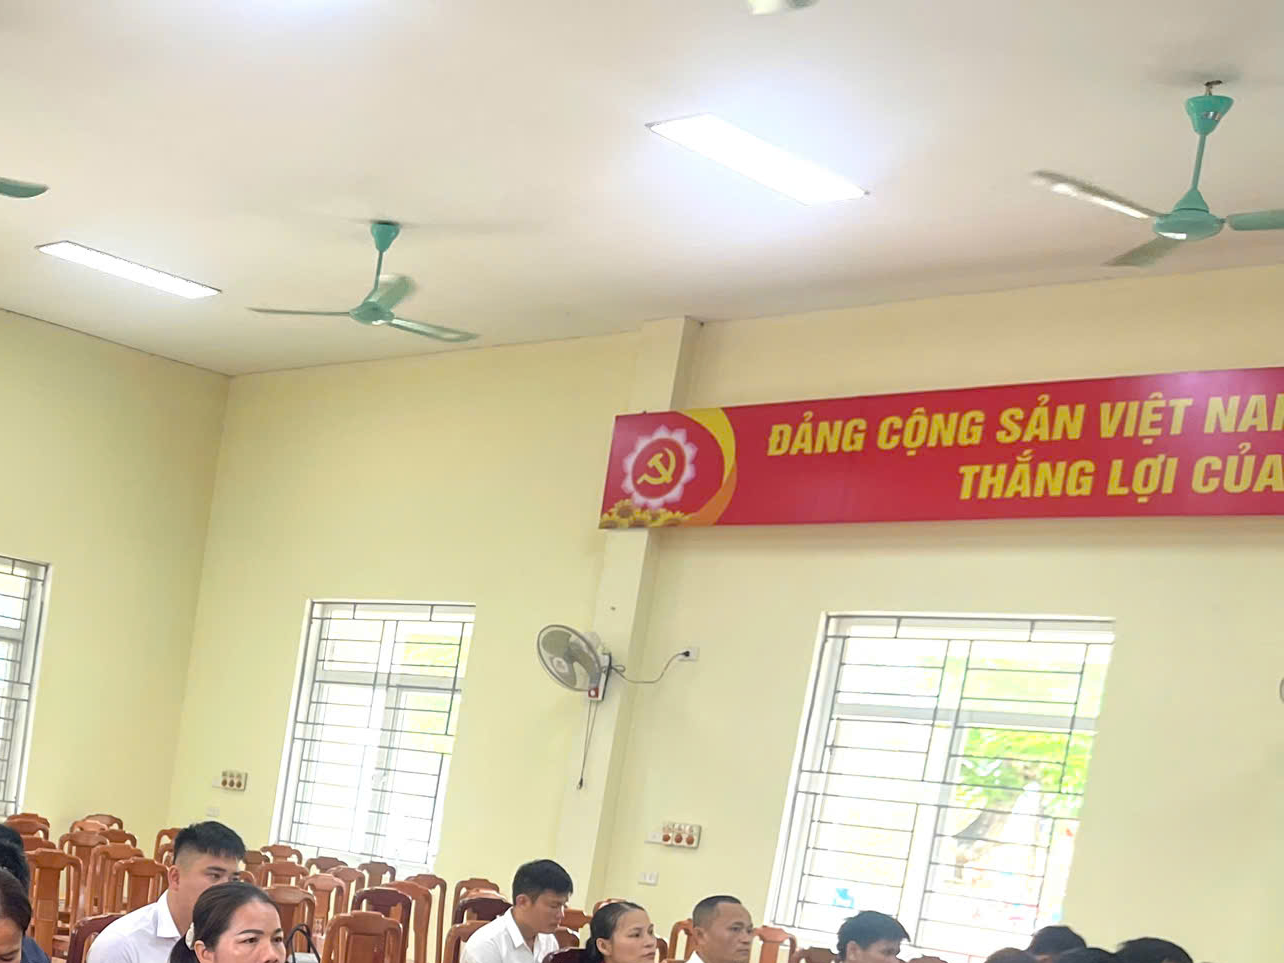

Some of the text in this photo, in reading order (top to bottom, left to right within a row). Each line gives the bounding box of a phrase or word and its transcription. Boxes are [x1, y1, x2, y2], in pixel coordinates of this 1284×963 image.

[767, 411, 867, 456] ĐẢNG
[877, 407, 985, 456] CỘNG
[996, 394, 1086, 444] SẢN
[1100, 392, 1193, 445] VIỆT
[959, 442, 1284, 503] THẮNG LỢI CỦA
